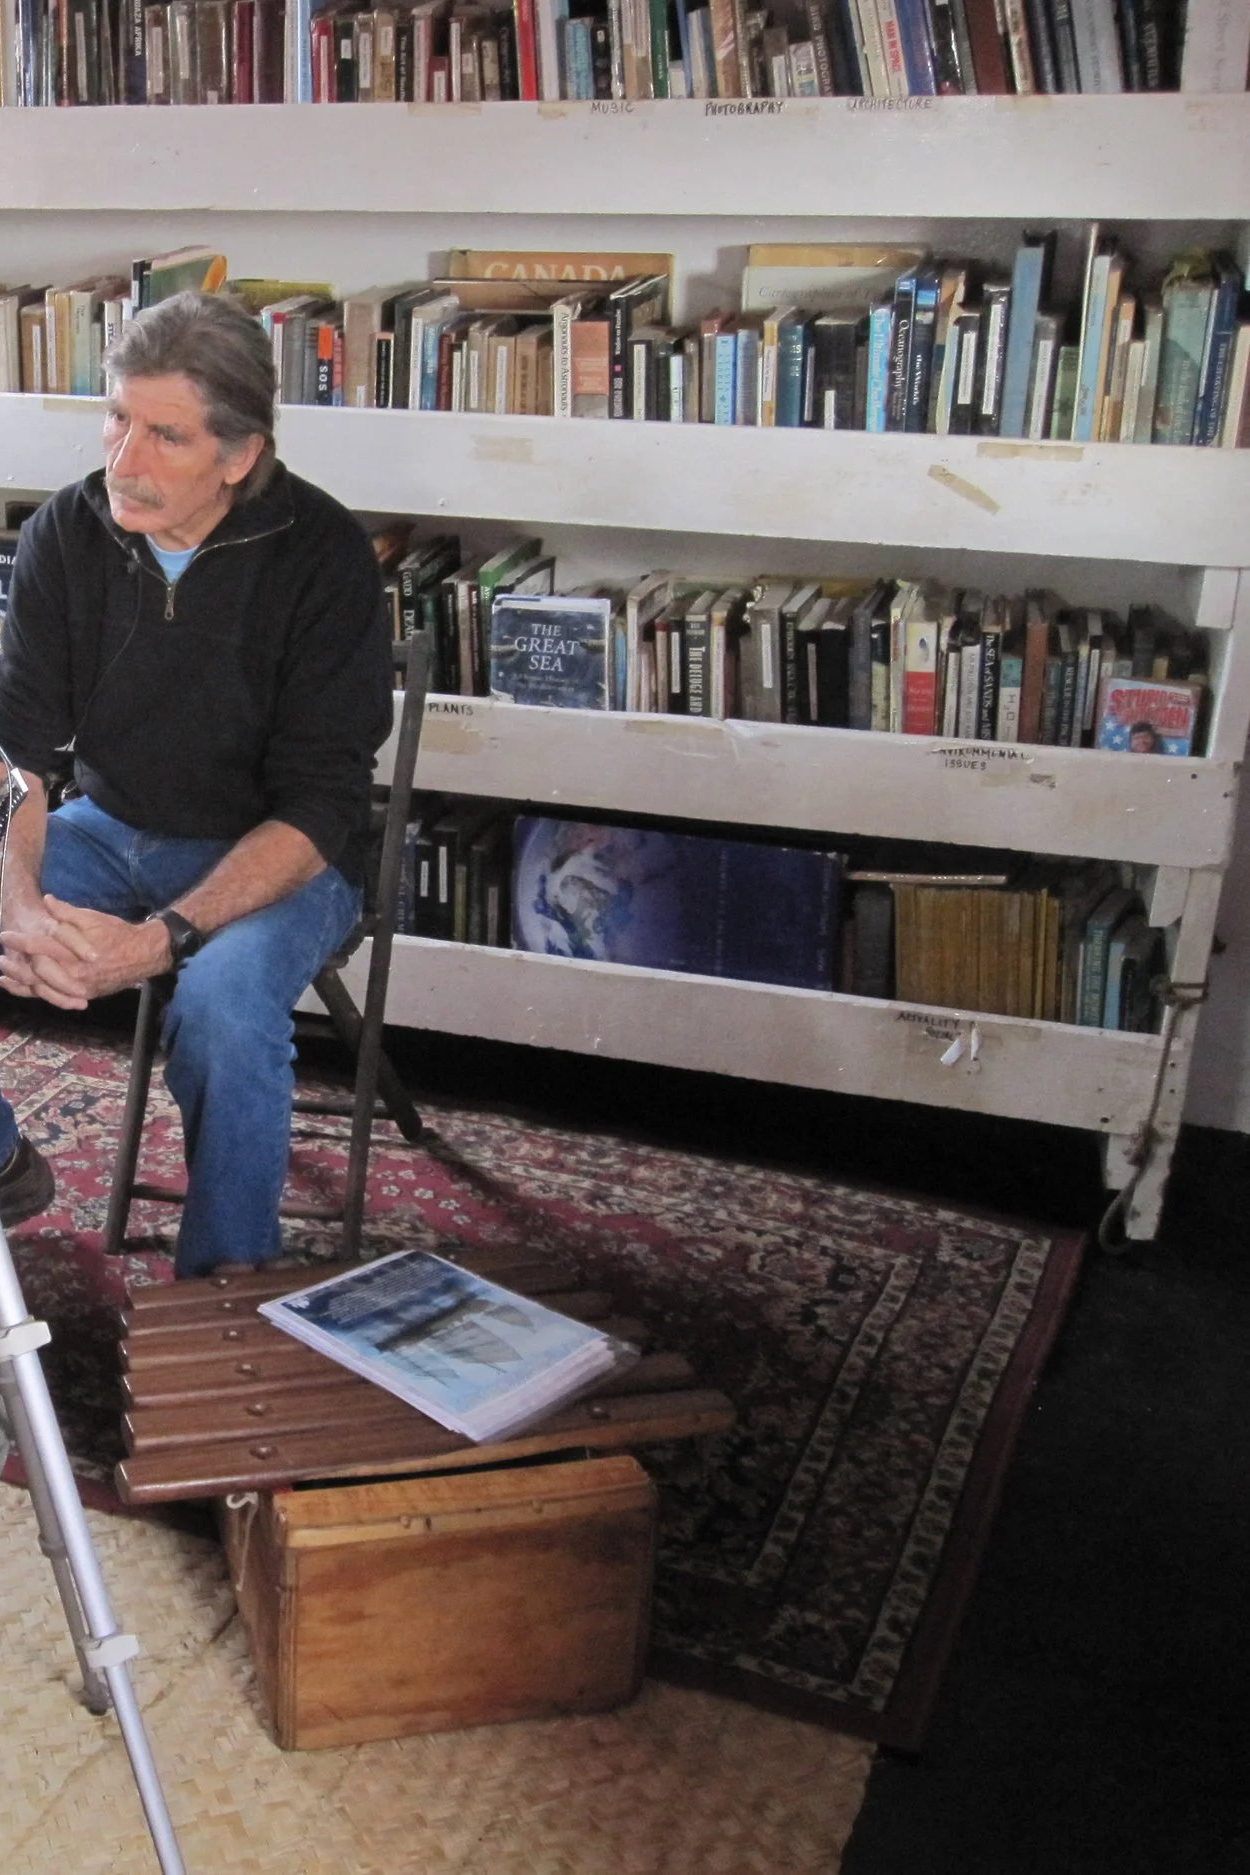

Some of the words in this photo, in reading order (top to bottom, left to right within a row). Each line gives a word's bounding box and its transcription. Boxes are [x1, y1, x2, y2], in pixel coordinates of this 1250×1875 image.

[885, 20, 897, 39] MAN
[888, 40, 898, 49] IN
[889, 50, 902, 74] SPACE
[590, 102, 634, 114] MUSIC
[705, 100, 784, 117] PHOTOGRAPHY
[483, 260, 626, 281] CANADA
[557, 312, 570, 355] Argonauts
[560, 357, 569, 366] to
[871, 333, 885, 377] Ultimate
[891, 319, 910, 388] Oceanography
[318, 365, 329, 391] SOS
[560, 368, 570, 411] Astronauts
[531, 623, 562, 637] THE
[514, 635, 580, 656] GREAT
[985, 634, 995, 647] The
[529, 654, 564, 673] SEA
[689, 646, 706, 662] THE
[984, 647, 995, 667] SEA
[689, 663, 703, 694] DELUGE
[983, 667, 991, 675] of
[983, 675, 992, 708] SANDS
[428, 702, 474, 716] PLANTS
[689, 696, 702, 713] AND
[981, 708, 990, 721] and
[944, 758, 987, 771] ISSUES
